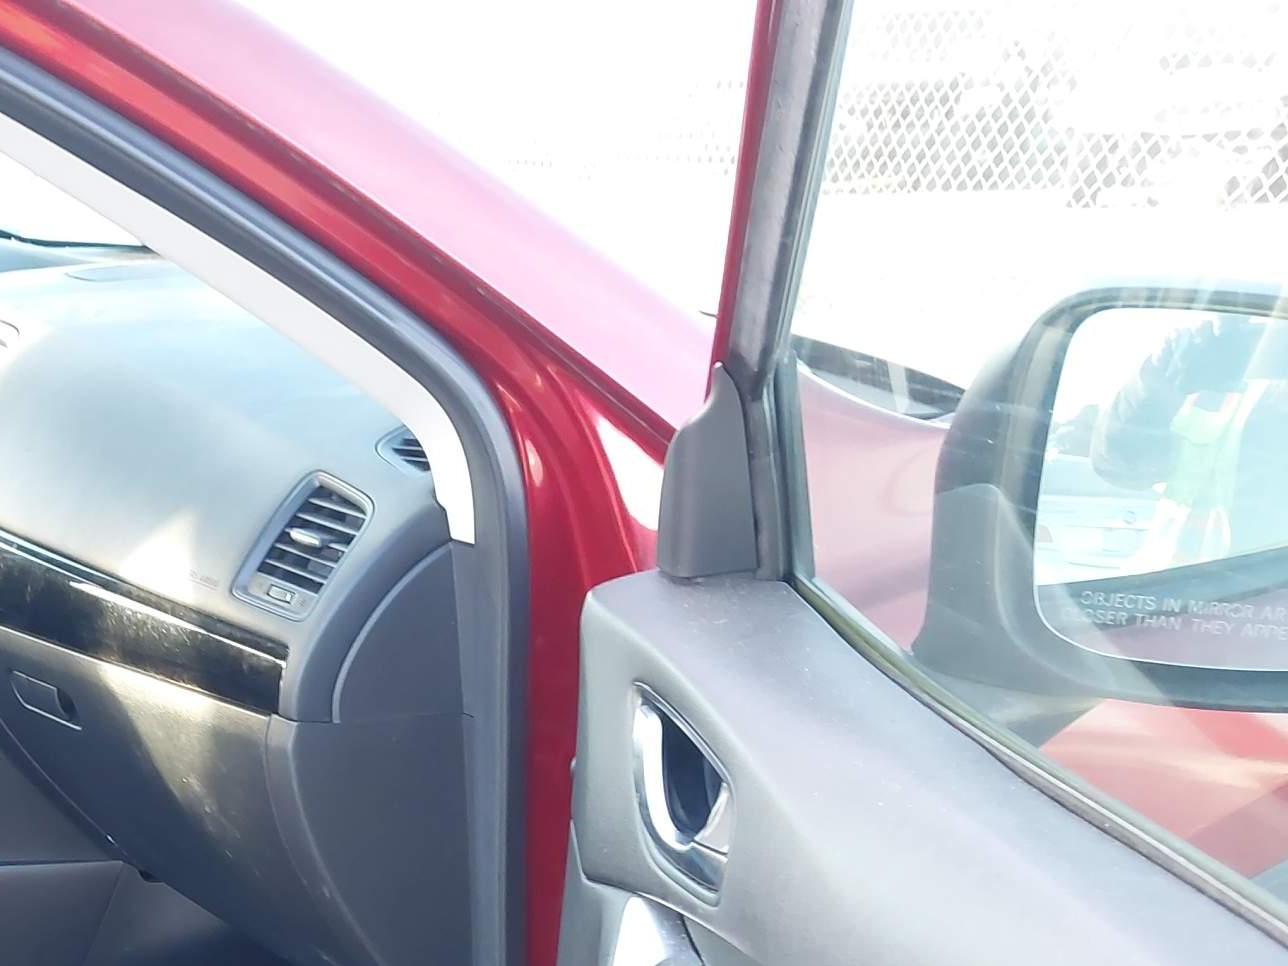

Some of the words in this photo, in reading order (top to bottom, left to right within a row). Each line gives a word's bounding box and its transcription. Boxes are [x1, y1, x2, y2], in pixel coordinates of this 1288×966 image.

[1080, 591, 1157, 611] OBJECTS
[1163, 600, 1181, 613] IN
[1188, 600, 1253, 618] MIRROR
[1135, 613, 1181, 631] THAN
[1191, 618, 1233, 636] THEY
